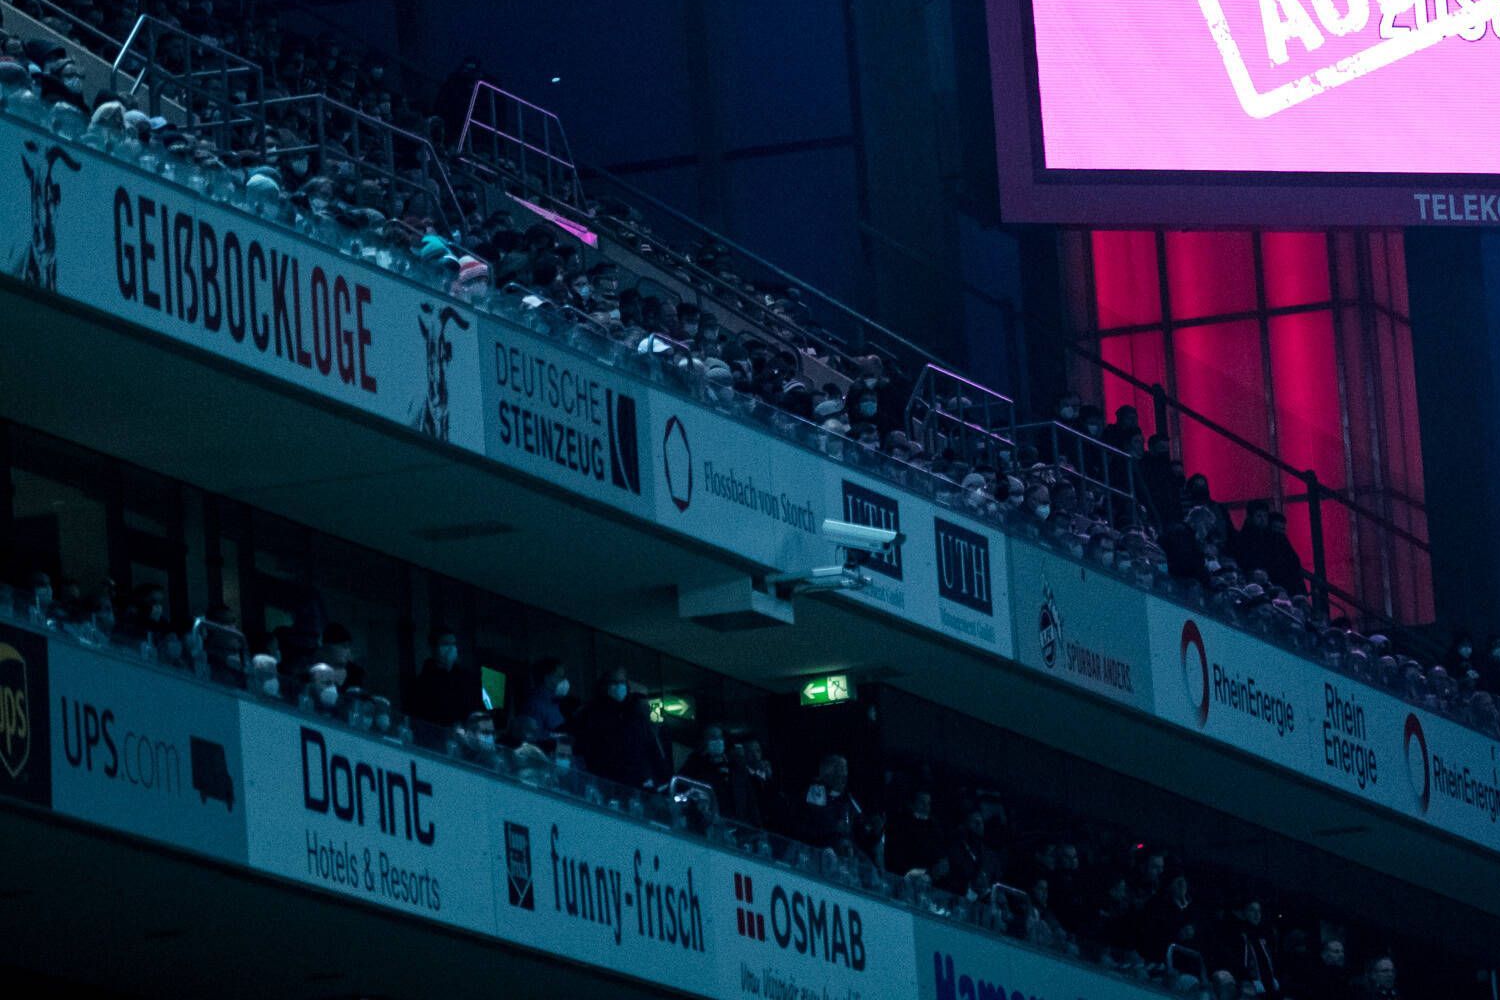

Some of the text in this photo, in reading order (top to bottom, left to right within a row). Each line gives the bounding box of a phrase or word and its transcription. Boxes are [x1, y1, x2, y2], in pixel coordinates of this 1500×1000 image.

[496, 341, 601, 426] DEUTSCHE
[499, 400, 604, 482] STEINZEUG
[704, 461, 816, 534] Flossbach von Storch
[939, 530, 988, 602] UTH
[1213, 663, 1295, 737] RheinEnergie
[1324, 682, 1367, 741] Rhein
[61, 695, 182, 798] UPS.com
[301, 726, 435, 846] Dorint
[1323, 720, 1378, 790] Energie
[305, 829, 359, 889] Hotels
[363, 847, 376, 893] &
[380, 852, 441, 911] Resorts
[550, 823, 705, 952] funny-frisch
[770, 885, 866, 972] OSMAB
